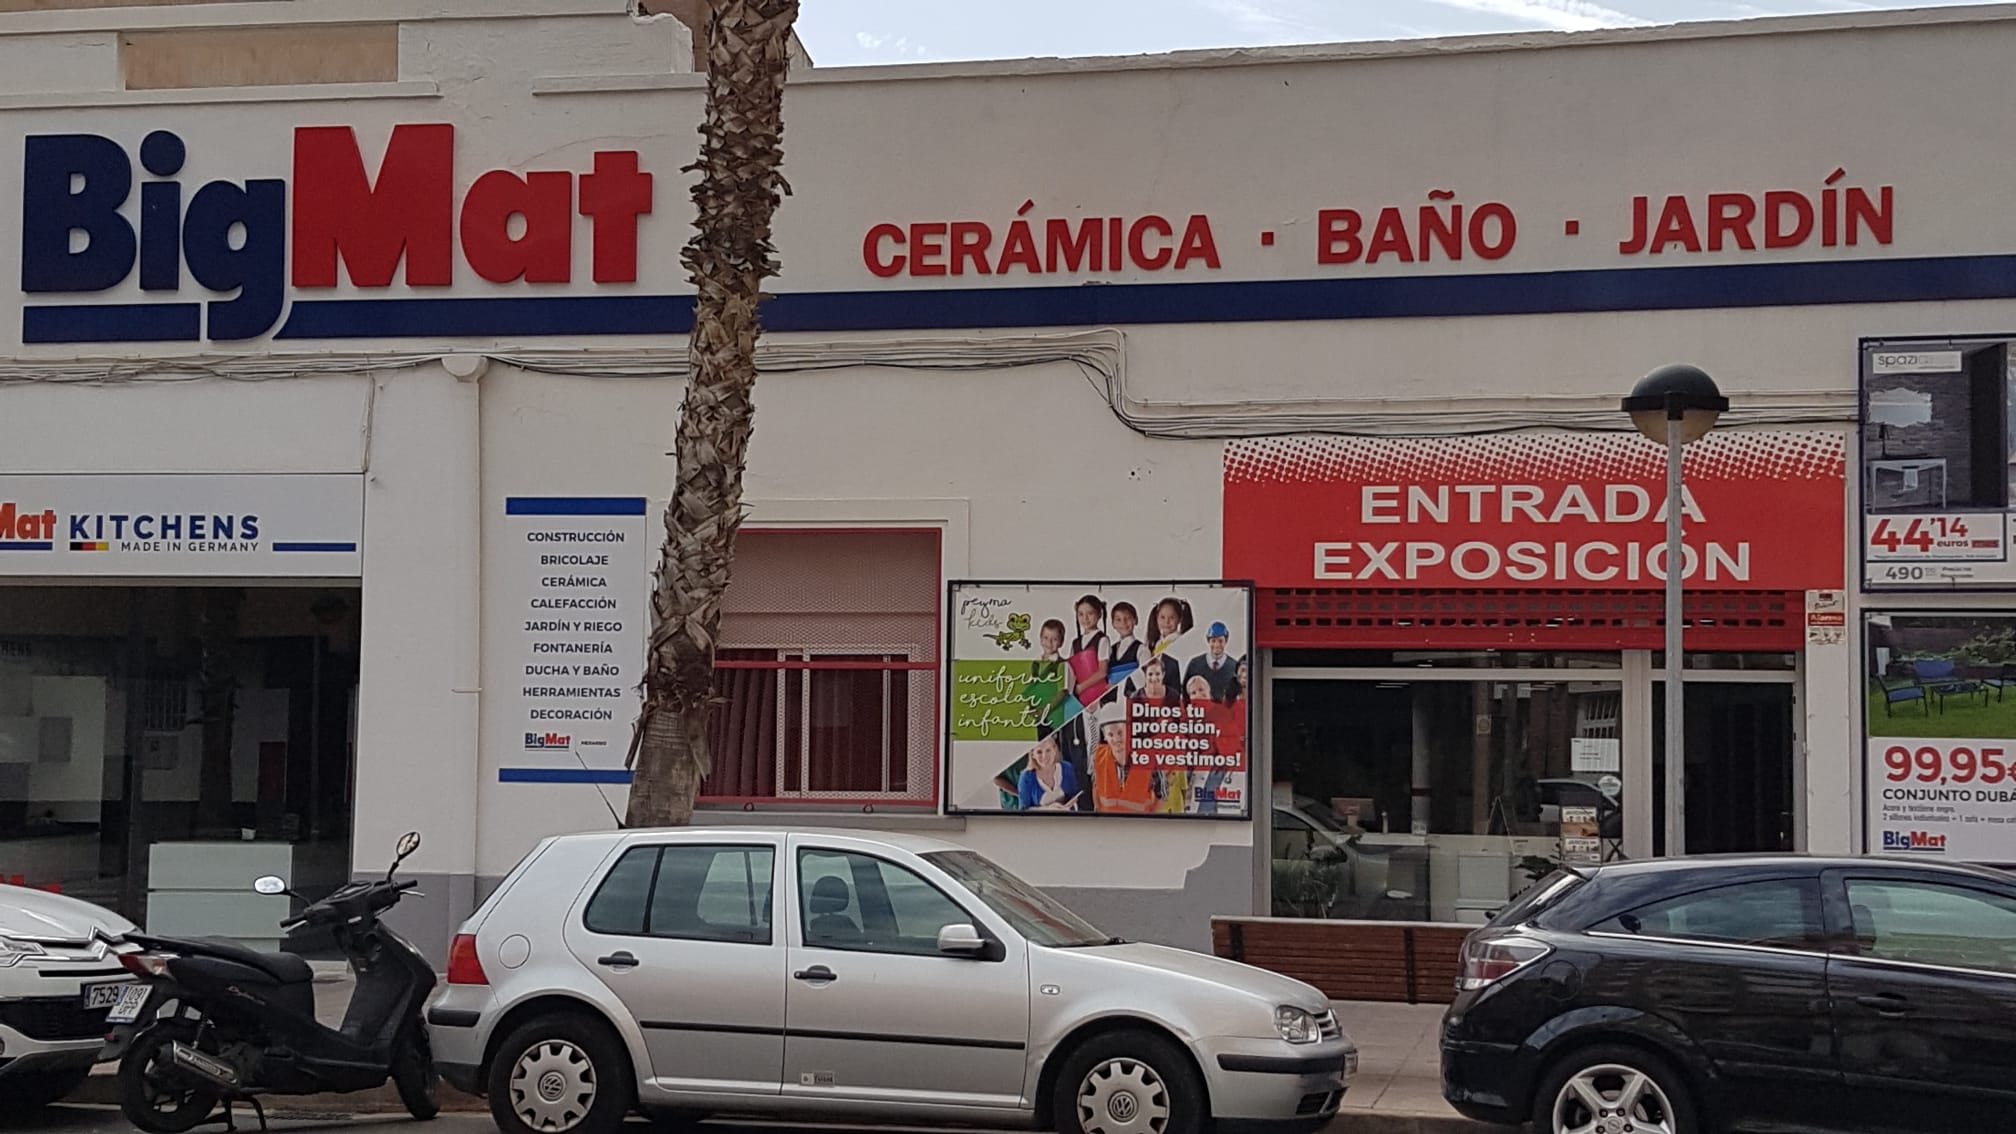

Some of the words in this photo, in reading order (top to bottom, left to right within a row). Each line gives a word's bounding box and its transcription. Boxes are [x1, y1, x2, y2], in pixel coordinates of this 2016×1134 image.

[863, 199, 1221, 278] CERÁMICA
[1317, 190, 1517, 265] BAÑO
[1619, 167, 1893, 254] JARDÍN
[22, 123, 652, 340] BigMat
[1361, 484, 1706, 523] ENTRADA
[70, 515, 259, 540] KITCHENS
[527, 530, 625, 542] CONSTRUCCIÓN
[121, 542, 161, 552] MADE
[167, 542, 181, 552] IN
[188, 542, 259, 552] GERMANY
[1937, 540, 1969, 548] euros
[541, 555, 609, 565] BRICOLAJE
[1312, 529, 1750, 581] EXPOSICIÓN
[1885, 566, 1923, 580] 490
[541, 575, 607, 587] CERÁMICA
[530, 597, 617, 609] CALEFACCIÓN
[524, 619, 570, 631] JARDÍN
[573, 621, 581, 631] Y
[584, 621, 623, 632] RIEGO
[533, 640, 613, 653] FONTANERÍA
[525, 665, 569, 676] DUCHA
[572, 666, 580, 676] Y
[583, 664, 620, 676] BAÑO
[959, 665, 1062, 692] uniforme
[522, 687, 621, 698] HERRAMIENTAS
[960, 681, 1041, 708] escolar
[530, 708, 612, 720] DECORACIÓN
[1131, 703, 1182, 718] Dinos
[1186, 703, 1205, 718] tu
[958, 703, 1053, 736] infantil
[1131, 719, 1221, 737] profesión,
[525, 732, 571, 747] BigMat
[1131, 736, 1210, 750] nosotros
[1131, 751, 1150, 765] te
[1155, 751, 1241, 767] vestimos!
[1882, 788, 1972, 802] CONJUNTO
[1883, 831, 1947, 849] BigMat
[92, 986, 119, 1006] 7529
